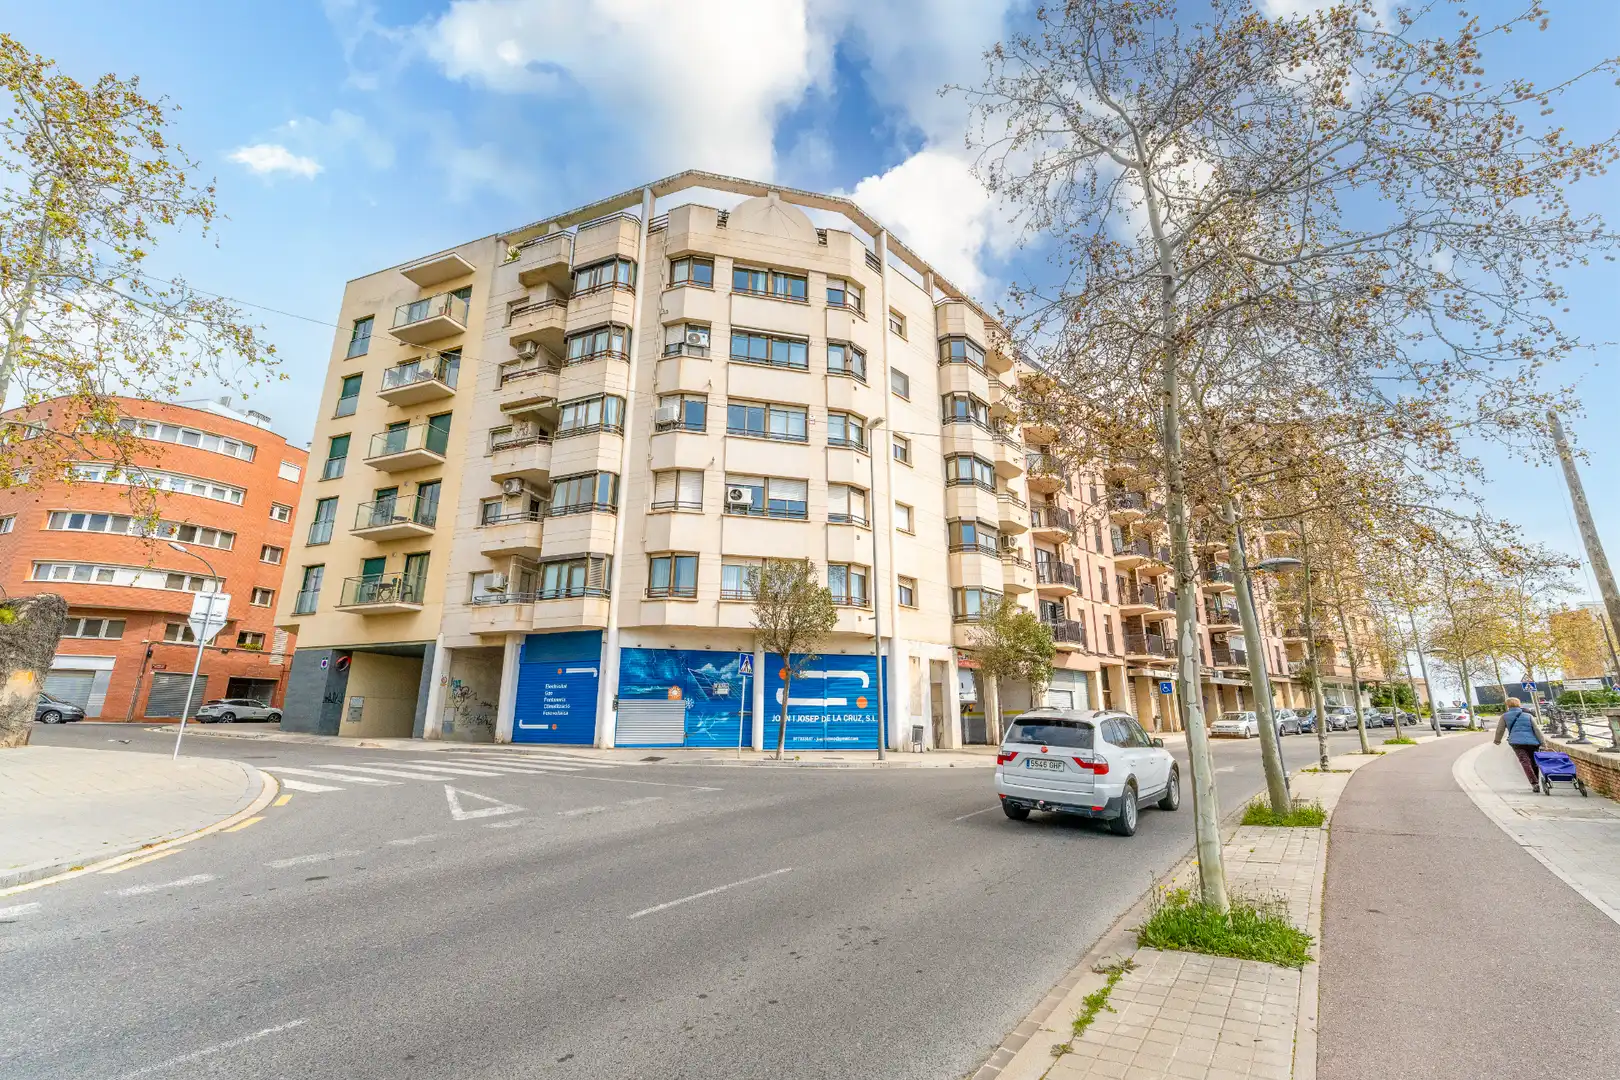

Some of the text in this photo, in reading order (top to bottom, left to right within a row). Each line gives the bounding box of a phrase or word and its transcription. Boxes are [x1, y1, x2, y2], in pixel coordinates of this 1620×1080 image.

[771, 714, 791, 722] JON
[796, 714, 820, 723] JOSEP
[821, 714, 831, 723] DE
[832, 714, 842, 722] LA
[843, 714, 864, 723] CRUZ,
